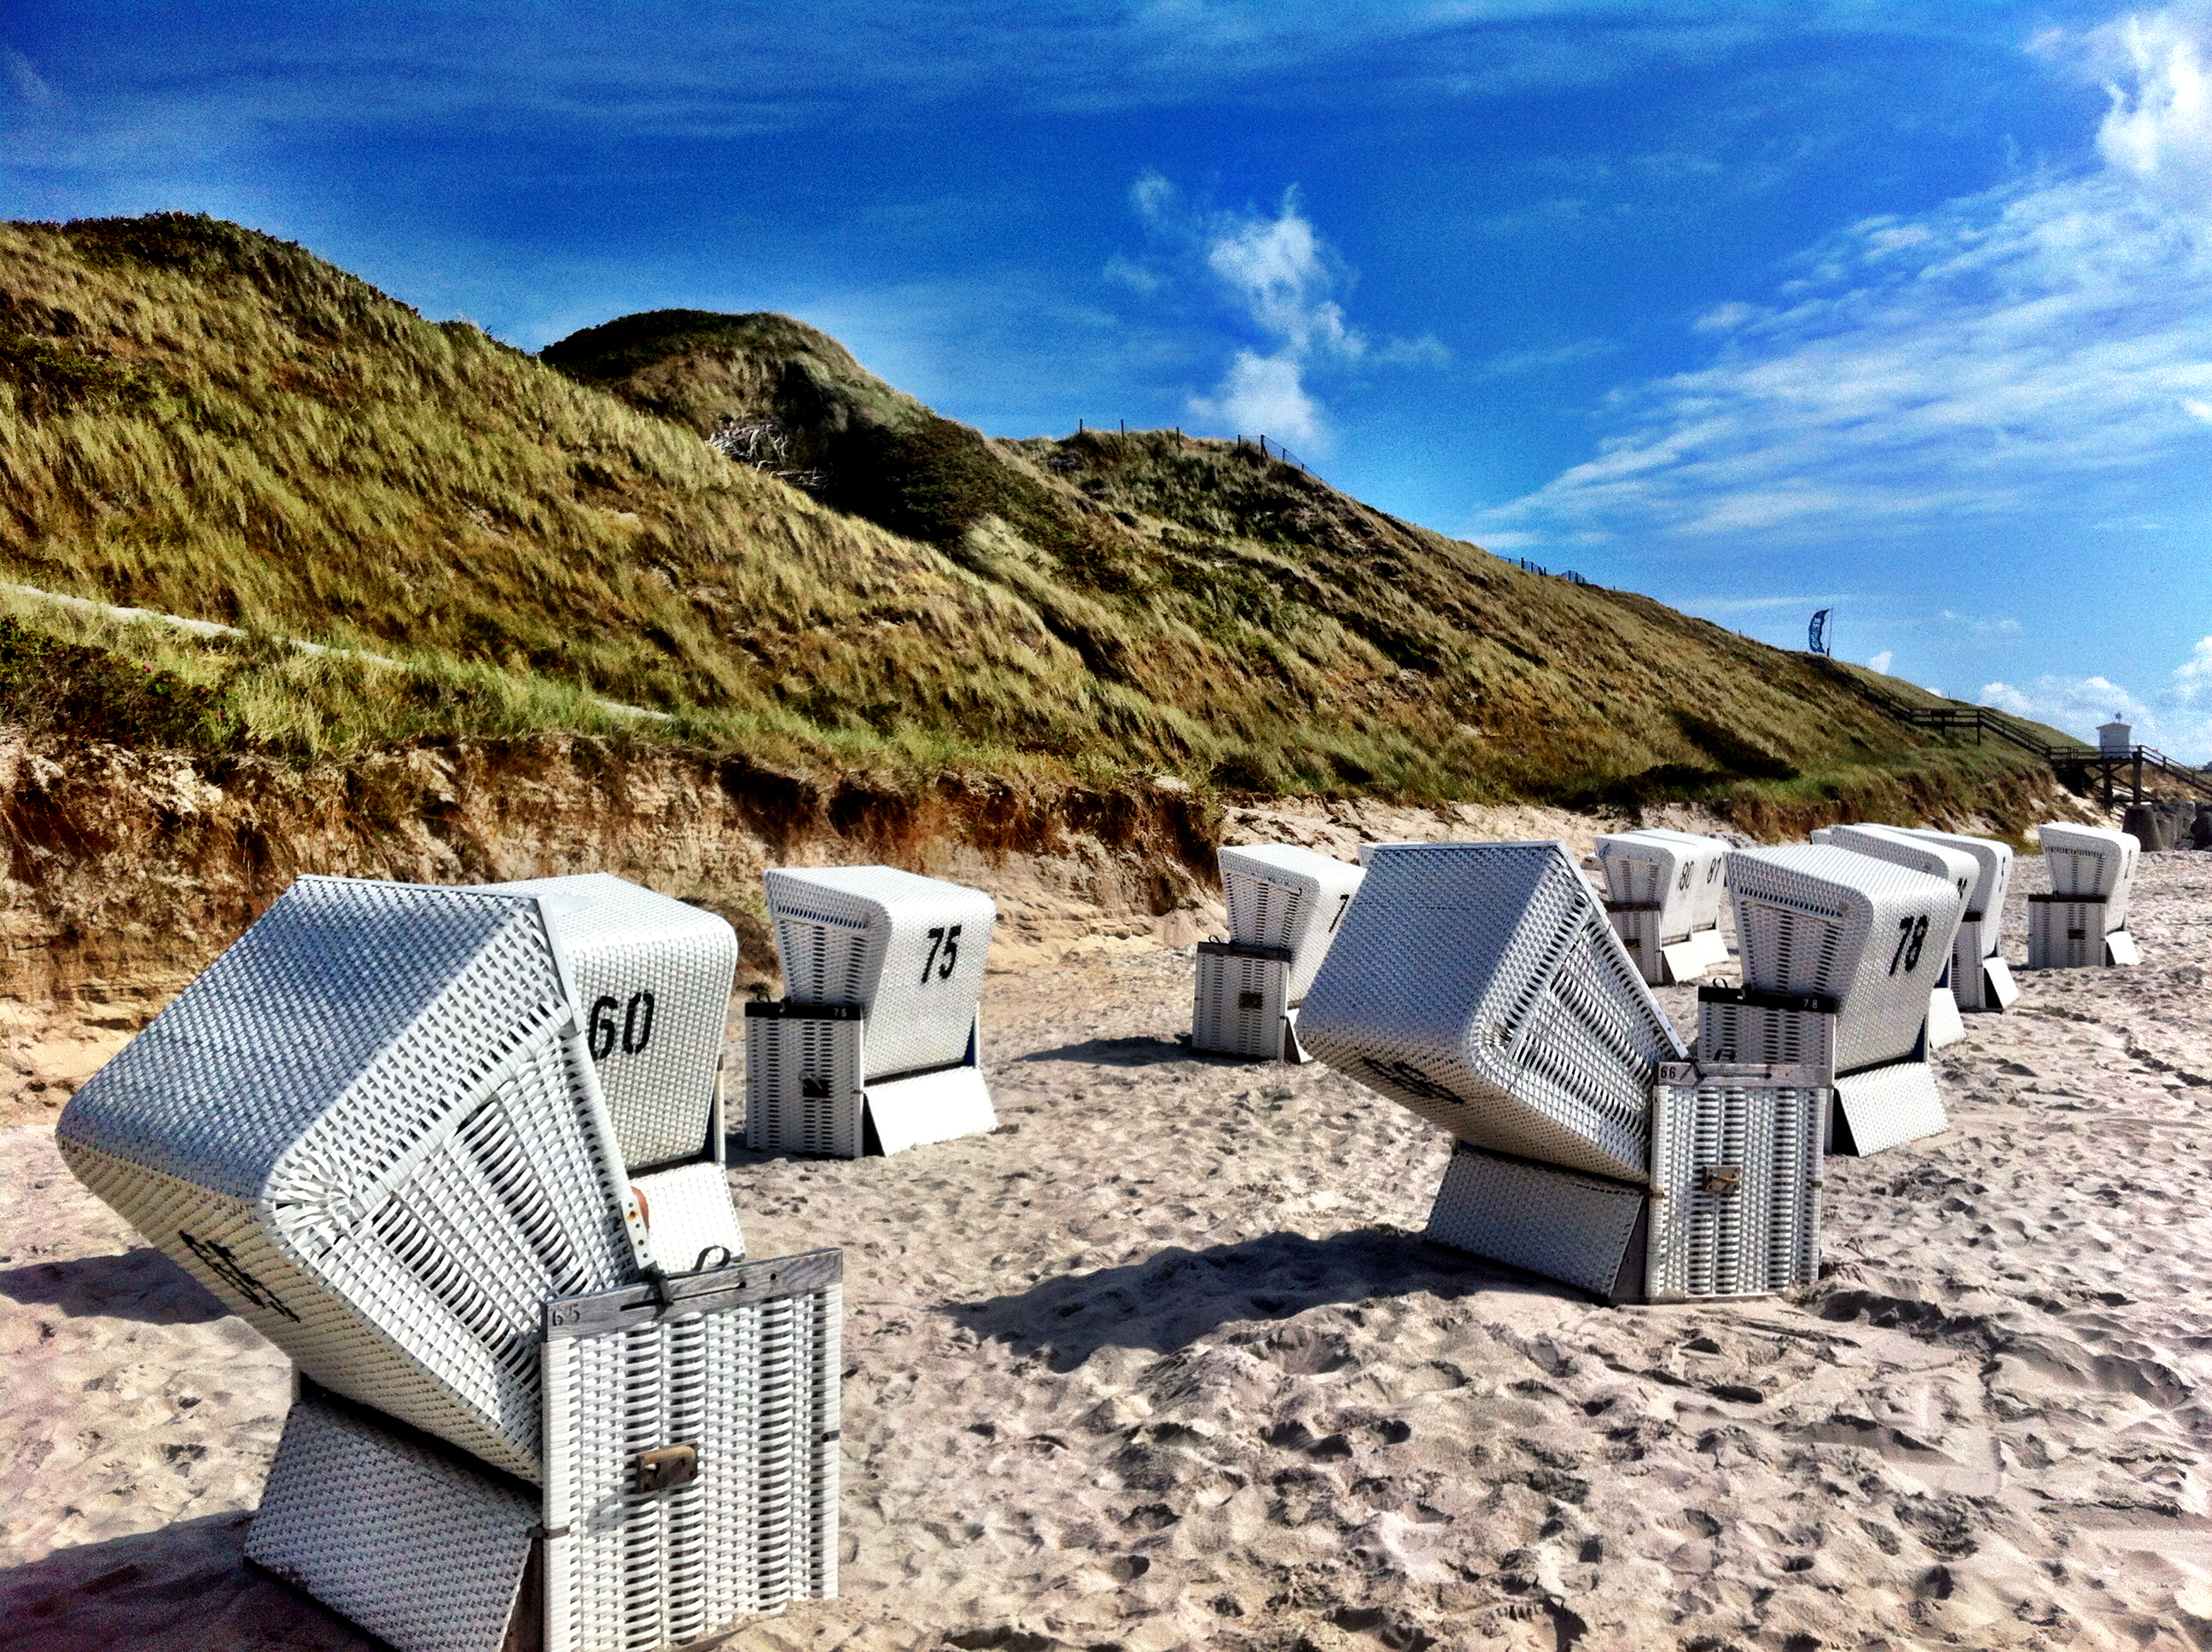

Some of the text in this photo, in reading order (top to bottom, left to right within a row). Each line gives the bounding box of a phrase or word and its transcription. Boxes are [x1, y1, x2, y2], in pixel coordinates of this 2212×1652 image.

[1679, 860, 1694, 892] 80
[1707, 857, 1722, 884] 81
[919, 923, 962, 985] 75
[1888, 914, 1930, 977] 78
[1803, 998, 1819, 1009] 78
[587, 989, 655, 1062] 60
[1660, 1065, 1677, 1079] 66
[551, 1302, 580, 1327] 65
